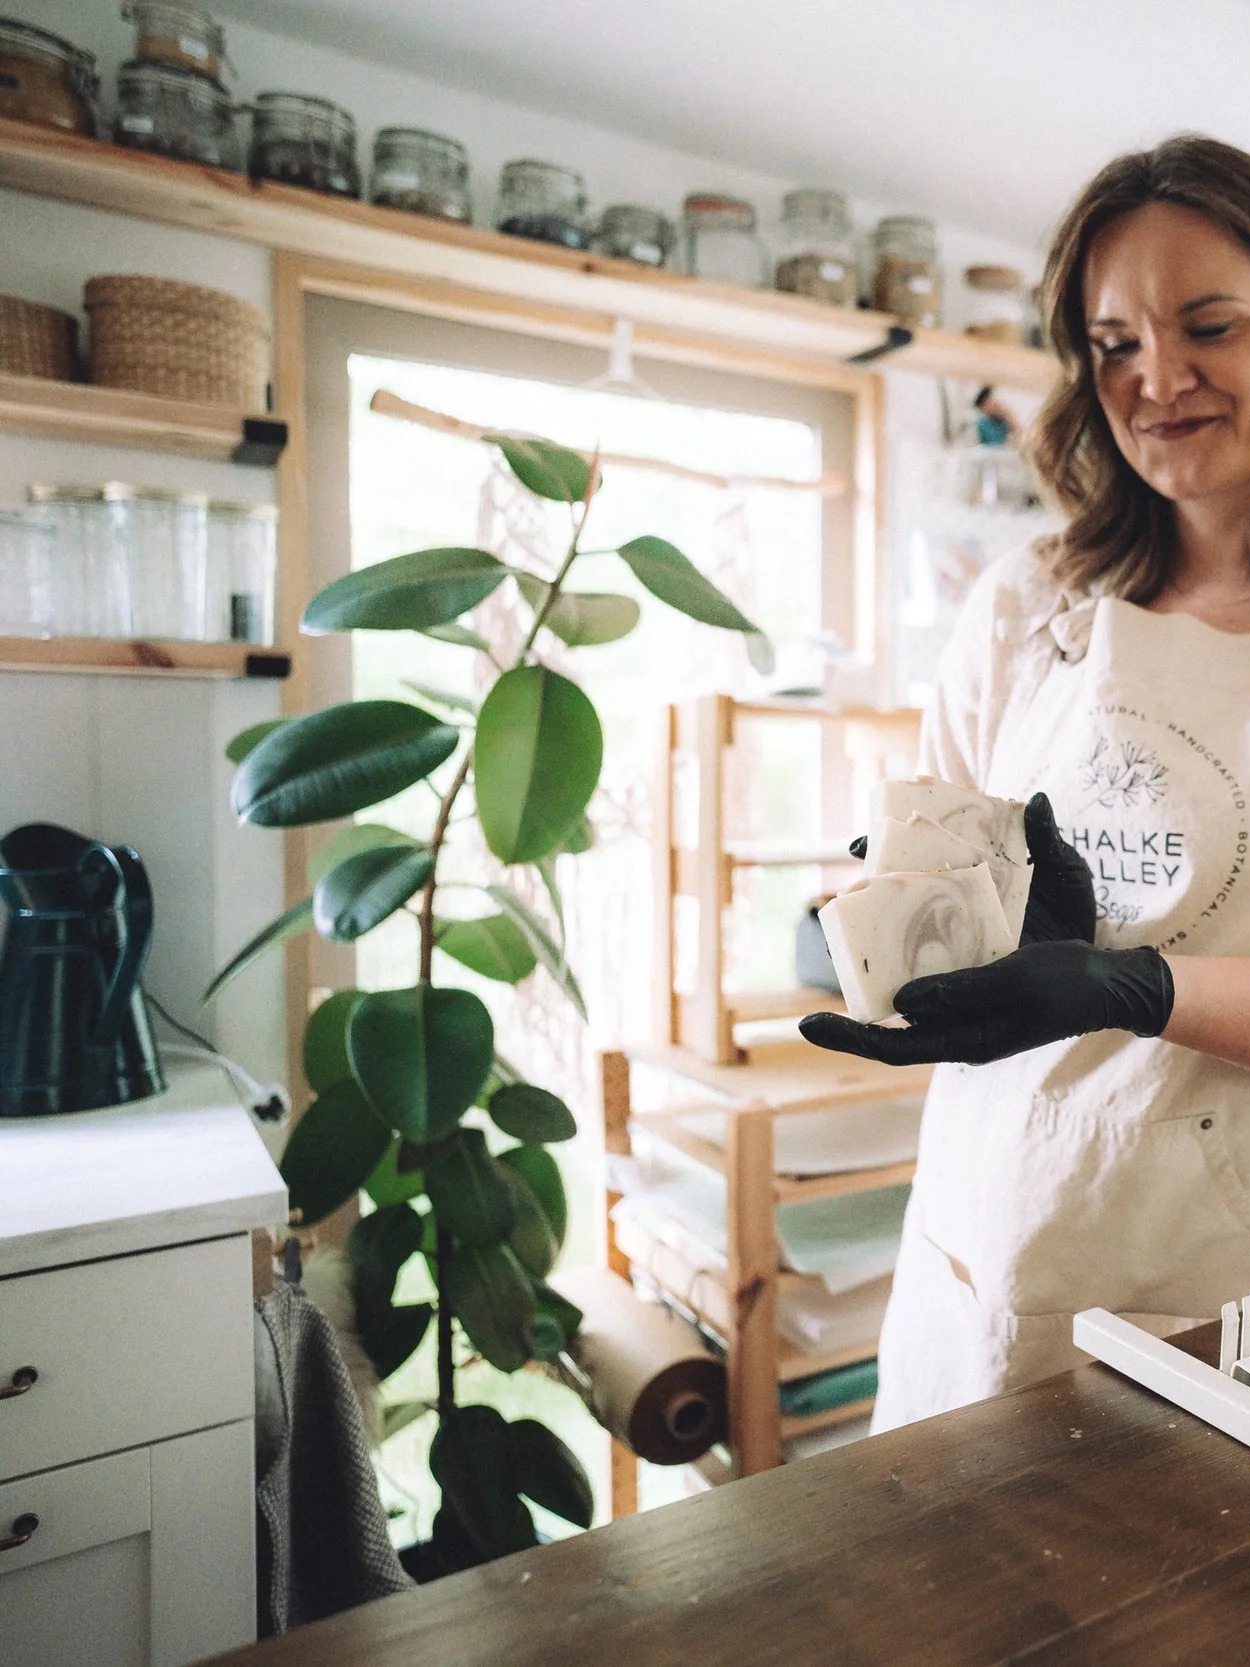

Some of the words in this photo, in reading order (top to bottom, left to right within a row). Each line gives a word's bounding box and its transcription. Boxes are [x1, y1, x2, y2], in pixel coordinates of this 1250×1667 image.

[1088, 704, 1147, 722] TURAL
[1168, 723, 1246, 811] HANDCRAFTED
[1058, 828, 1184, 857] HALKE
[1092, 858, 1180, 887] LLEY
[1201, 831, 1249, 918] BOTANICAL
